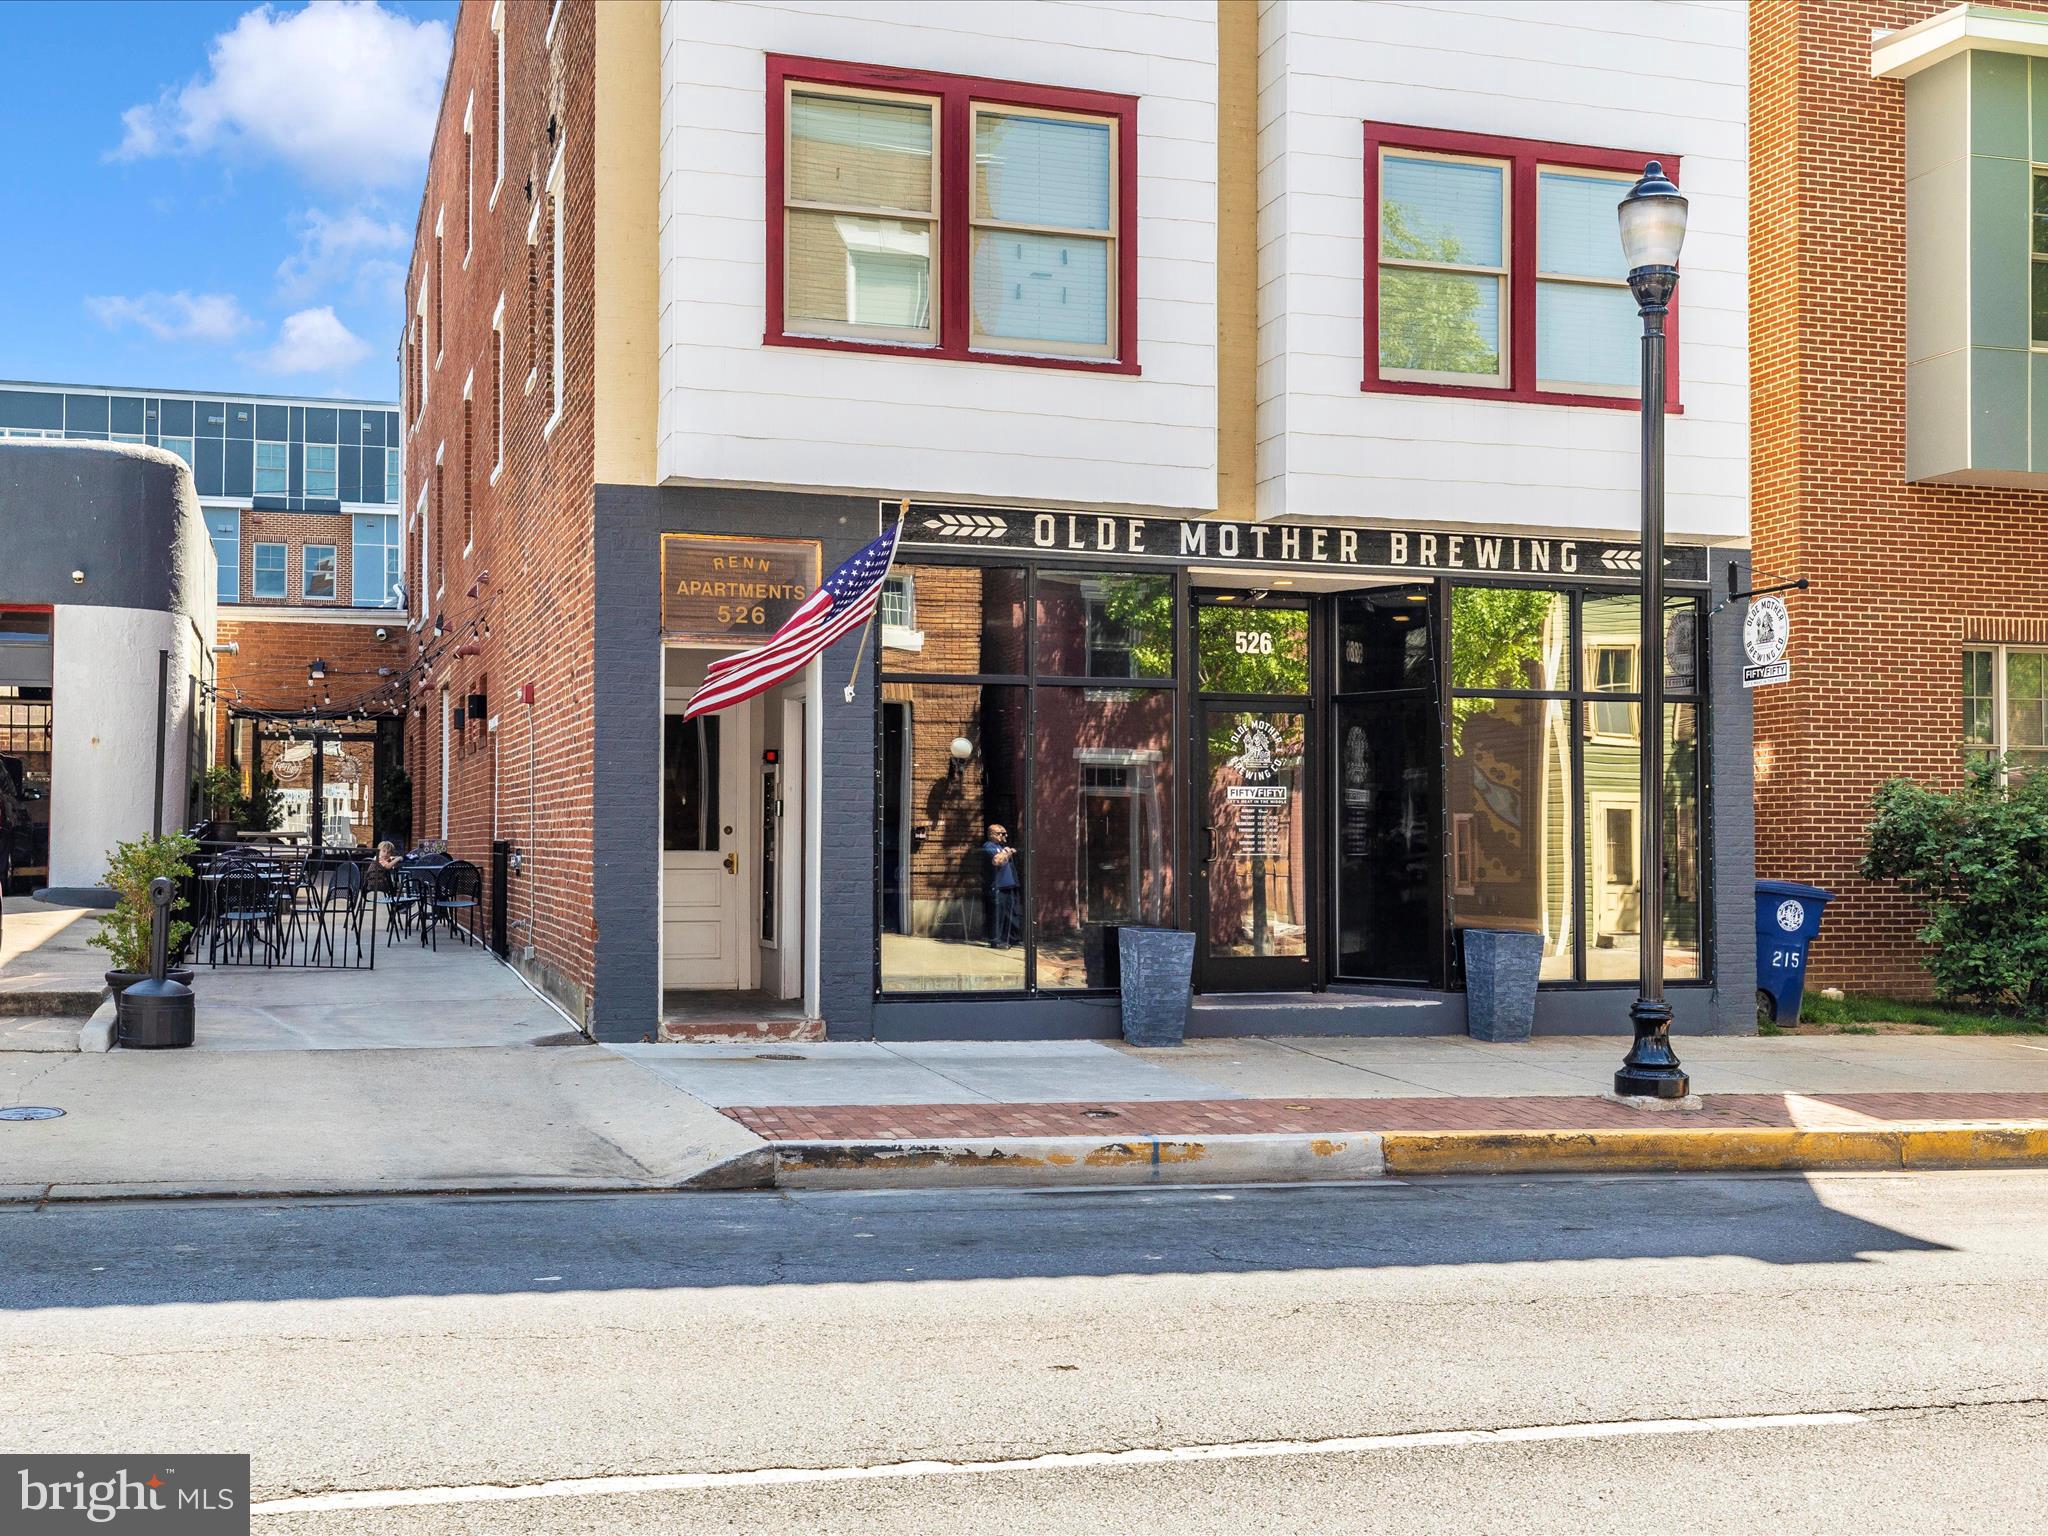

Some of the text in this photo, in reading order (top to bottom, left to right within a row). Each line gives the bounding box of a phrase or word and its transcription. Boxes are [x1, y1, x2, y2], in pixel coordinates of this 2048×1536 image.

[1033, 513, 1577, 572] OLDE MOTHER BREWING
[713, 556, 770, 572] RENN
[677, 580, 806, 601] APARTMENTS
[717, 605, 765, 625] 526
[1747, 600, 1784, 627] OLDE MOTHER
[1235, 631, 1272, 654] 526
[1746, 641, 1776, 662] BREWING
[1230, 720, 1283, 744] OLDE MOTHER
[1230, 756, 1271, 781] BREWING
[1772, 951, 1800, 968] 215
